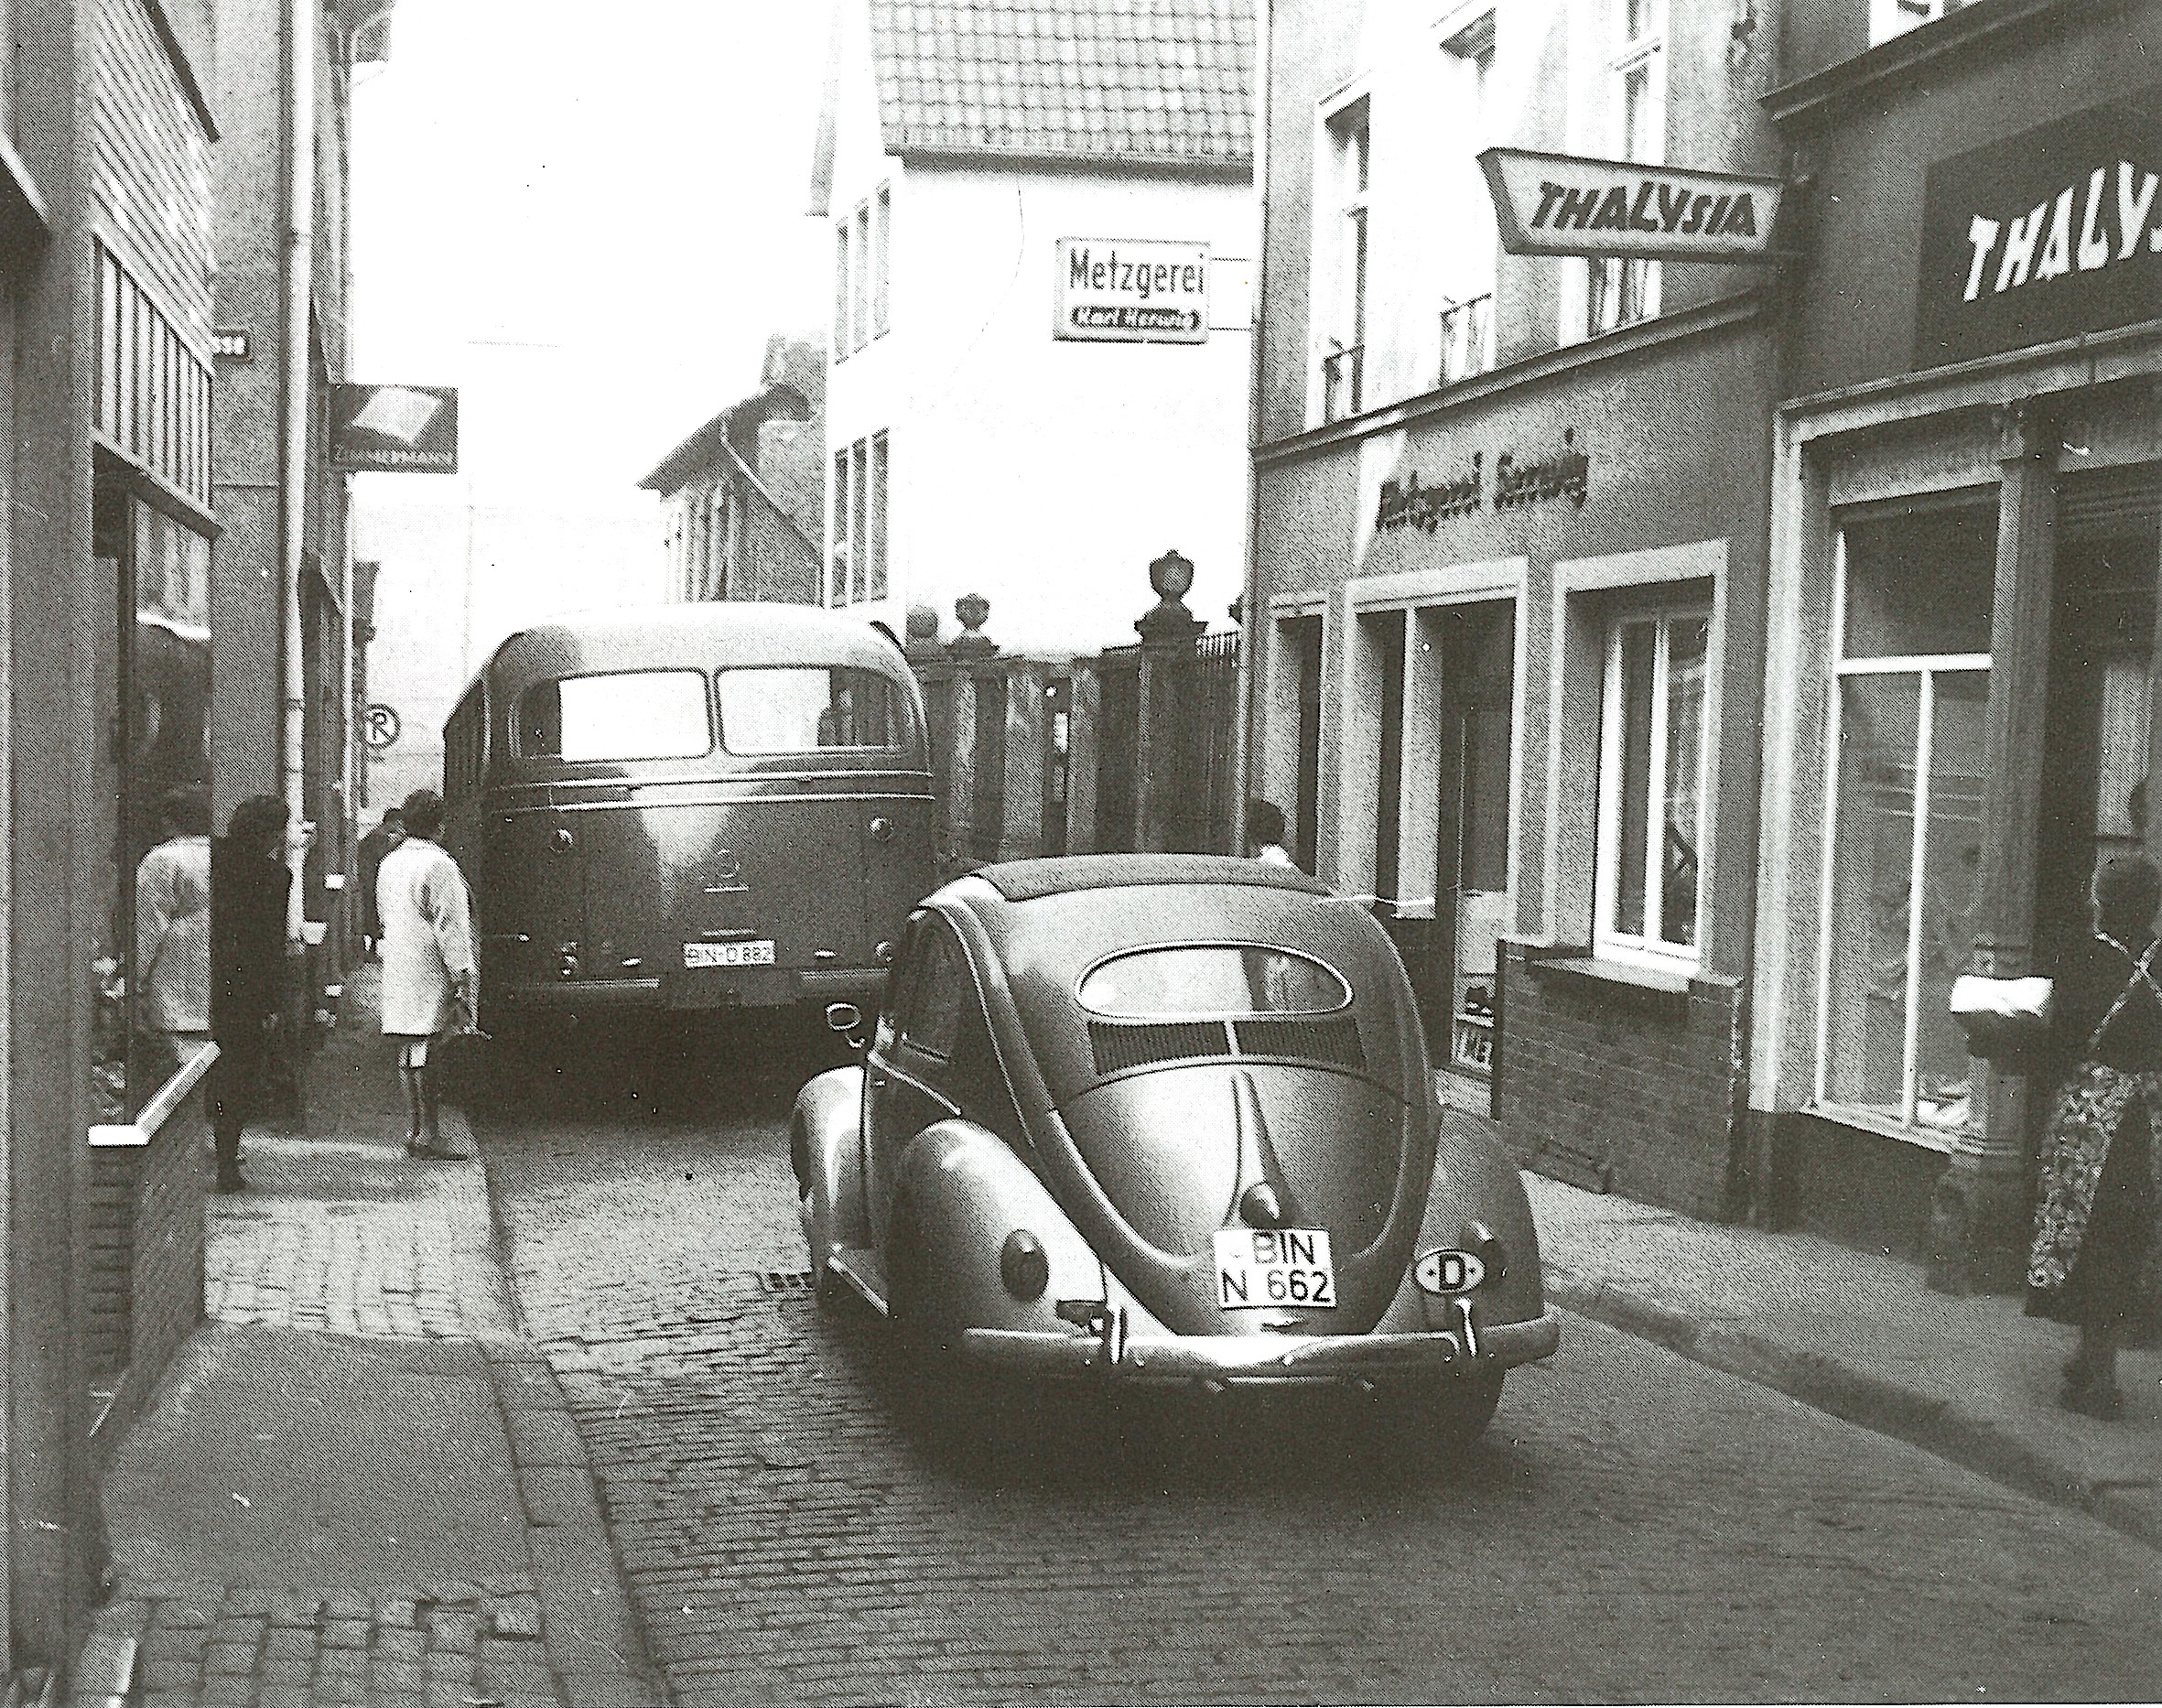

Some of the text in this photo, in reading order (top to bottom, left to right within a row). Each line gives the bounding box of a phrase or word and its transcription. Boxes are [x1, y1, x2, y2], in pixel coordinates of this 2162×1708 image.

[1530, 181, 1757, 237] THALYSIA
[1962, 159, 2162, 303] THALY
[1069, 248, 1204, 299] Metzgerei
[1252, 1232, 1316, 1265] BIN
[1221, 1268, 1332, 1303] N 662
[1438, 1253, 1465, 1291] D
